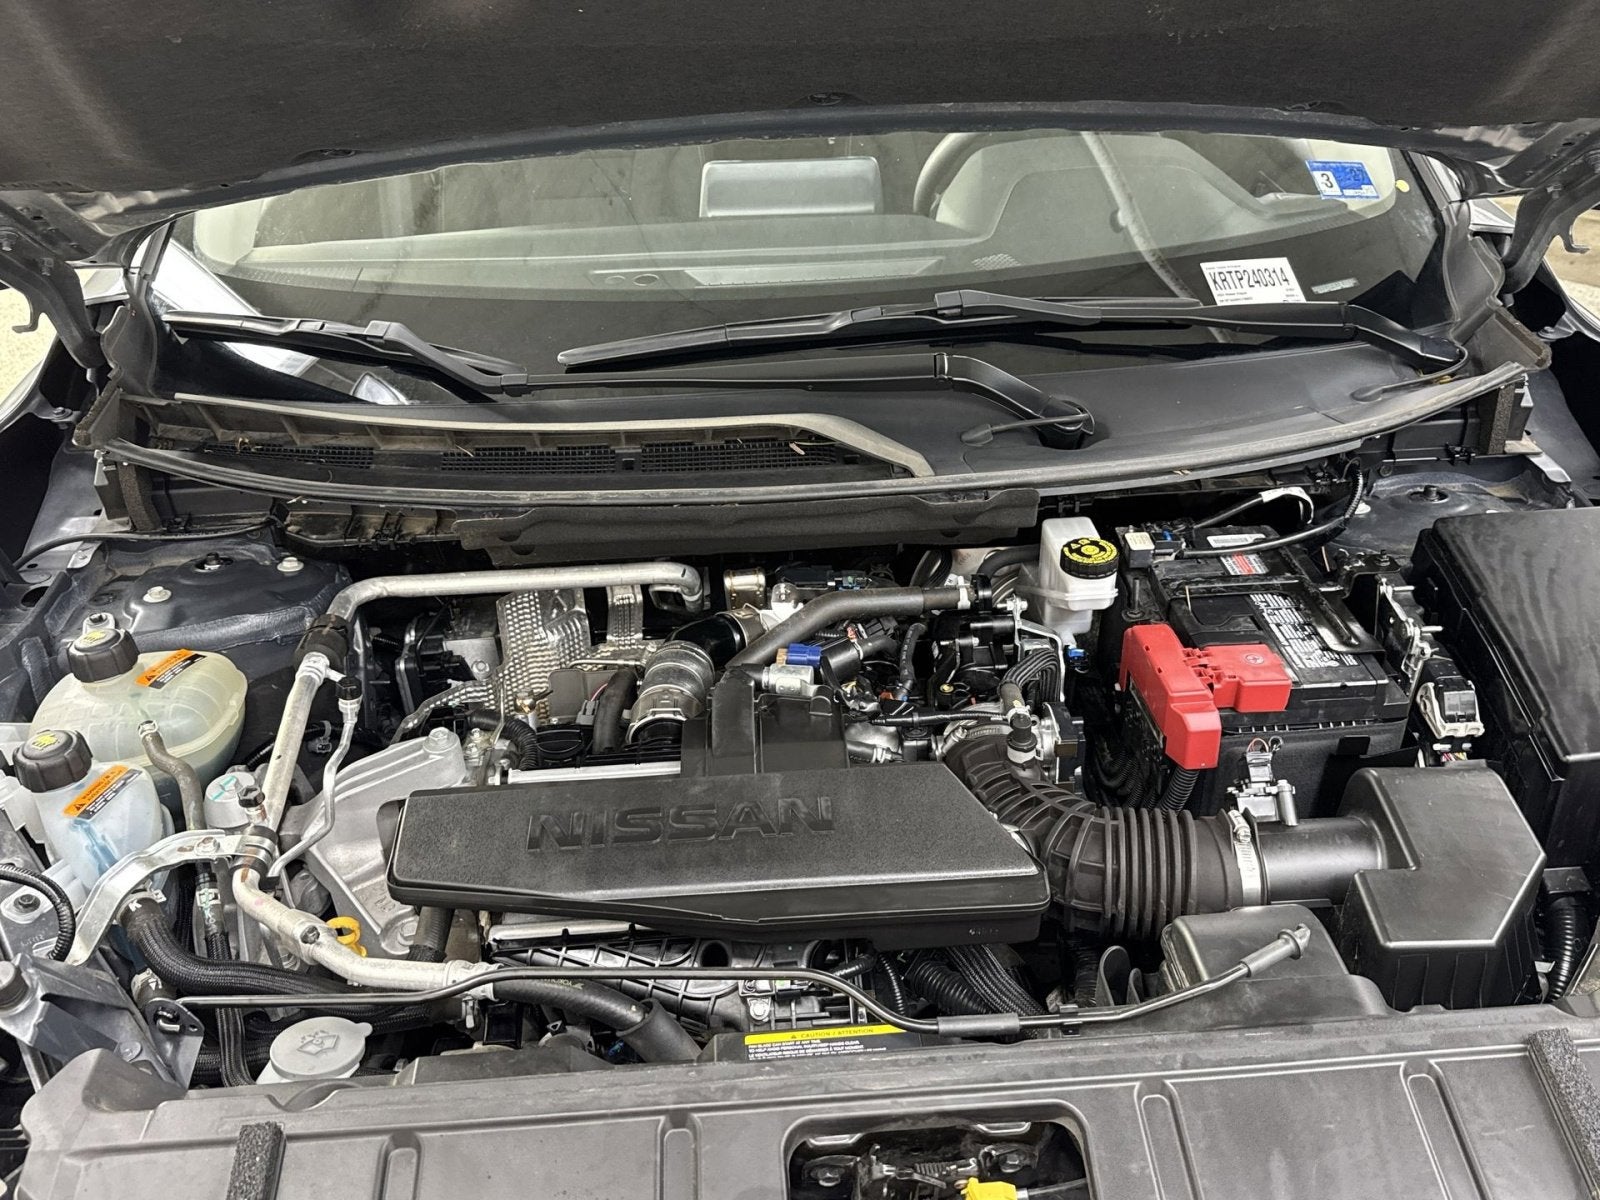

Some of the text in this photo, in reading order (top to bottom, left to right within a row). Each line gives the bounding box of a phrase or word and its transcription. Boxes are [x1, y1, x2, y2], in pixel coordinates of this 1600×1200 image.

[1321, 173, 1334, 189] 3
[1208, 267, 1290, 291] KRTP240314
[526, 795, 835, 852] NISSAN
